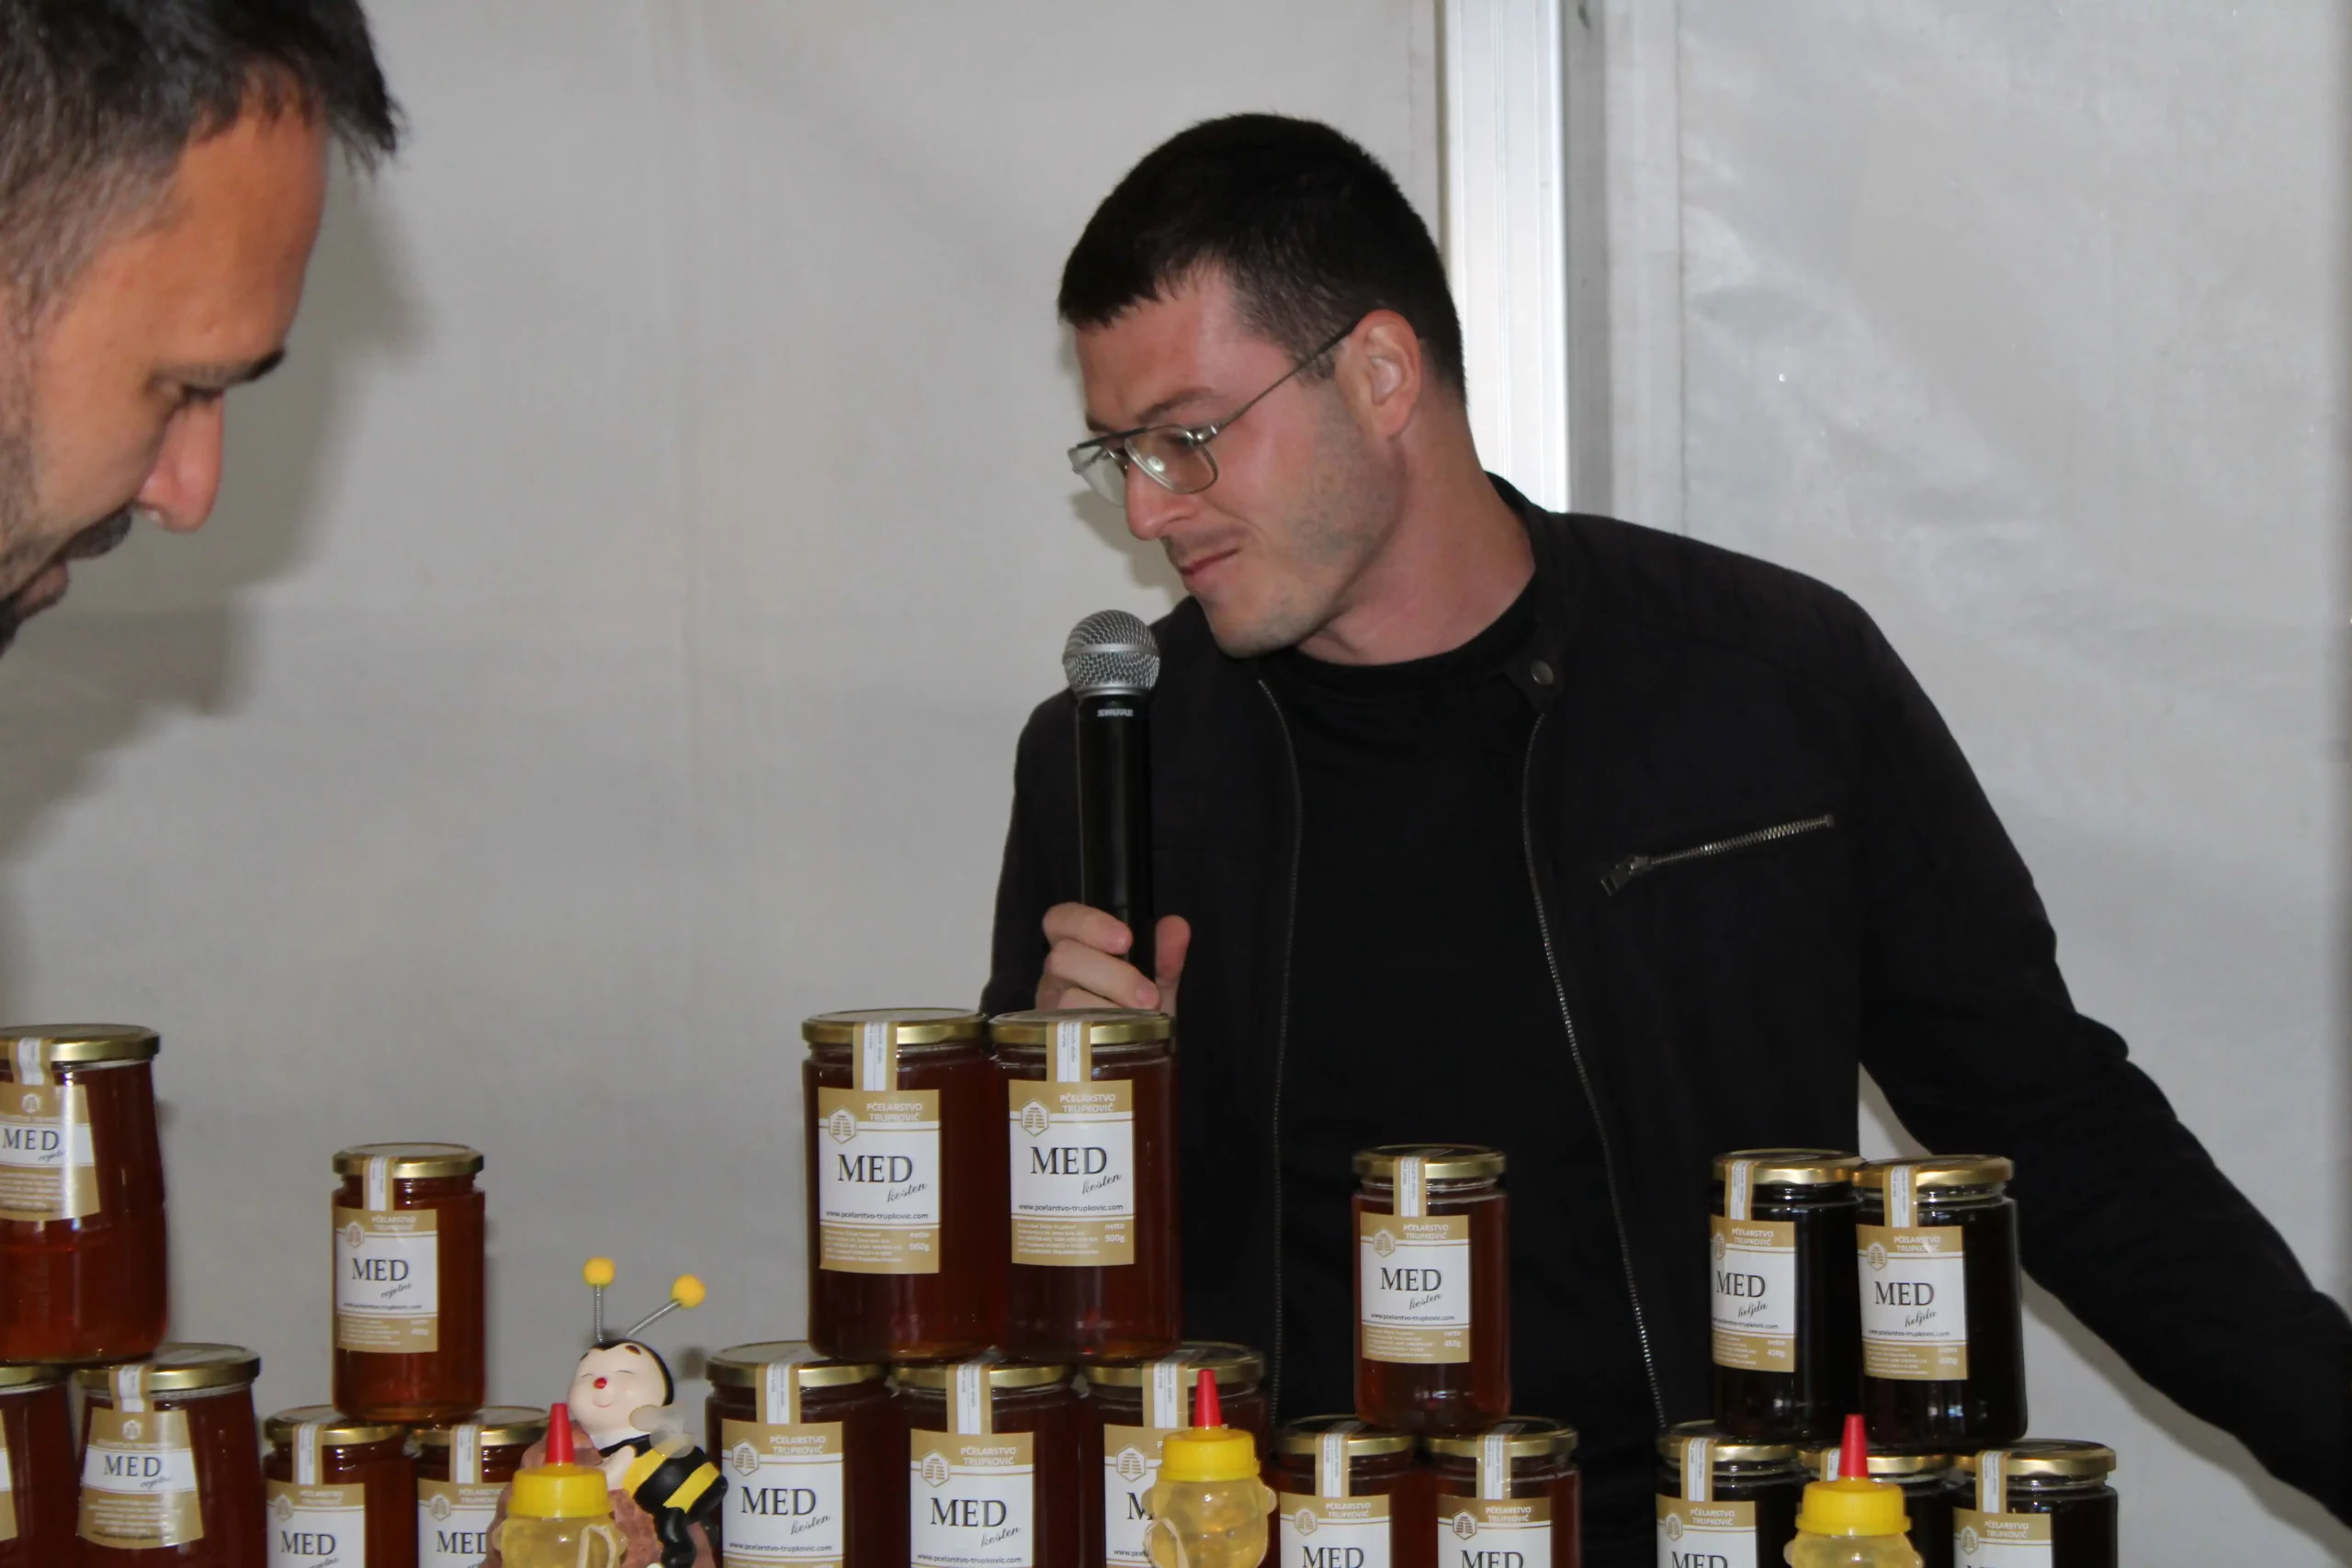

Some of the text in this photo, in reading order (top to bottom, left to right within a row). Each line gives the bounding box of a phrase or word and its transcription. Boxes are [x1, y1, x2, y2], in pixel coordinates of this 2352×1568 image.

[1097, 708, 1134, 717] SHURE
[1059, 1092, 1115, 1102] PČELARSTVO
[866, 1101, 922, 1111] PČELARSTVO
[1062, 1102, 1114, 1113] TRUPKOVIĆ
[869, 1111, 920, 1122] TRUPKOVIĆ
[2, 1128, 60, 1150] MED
[1030, 1146, 1107, 1175] MED
[837, 1154, 913, 1183] MED
[1081, 1173, 1122, 1195] kesten
[887, 1182, 928, 1203] kesten
[1018, 1203, 1123, 1212] www.pcelarstvo-trupkovic.com
[825, 1210, 929, 1221] www.pcelarstvo-trupkovic.com
[1403, 1223, 1449, 1232] PČELARSTVO
[1731, 1227, 1774, 1237] PČELARSTVO
[1104, 1234, 1125, 1243] 900g
[351, 1258, 410, 1281] MED
[1379, 1267, 1442, 1292] MED
[1716, 1270, 1766, 1298] MED
[1874, 1281, 1935, 1306] MED
[1408, 1293, 1442, 1310] kesten
[1737, 1301, 1768, 1318] heljda
[770, 1435, 826, 1445] PČELARSTVO
[771, 1445, 824, 1455] TRUPKOVIĆ
[960, 1446, 1017, 1455] PČELARSTVO
[104, 1454, 162, 1477] MED
[963, 1456, 1014, 1465] TRUPKOVIĆ
[741, 1485, 817, 1516] MED
[1326, 1501, 1371, 1511] PČELARSTVO
[930, 1497, 1007, 1528] MED
[1485, 1506, 1532, 1515] PČELARSTVO
[1690, 1507, 1736, 1517] PČELARSTVO
[789, 1516, 831, 1536] kesten
[1692, 1517, 1733, 1526] TRUPKOVIĆ
[280, 1531, 336, 1555] MED
[979, 1527, 1021, 1548] kesten
[729, 1541, 832, 1552] www.pcelarstvo-trupkovic.com
[917, 1552, 1023, 1564] www.pcelarstvo-trupkovic.com
[1302, 1546, 1364, 1568] MED
[1460, 1550, 1524, 1568] MED
[1671, 1551, 1729, 1568] MED
